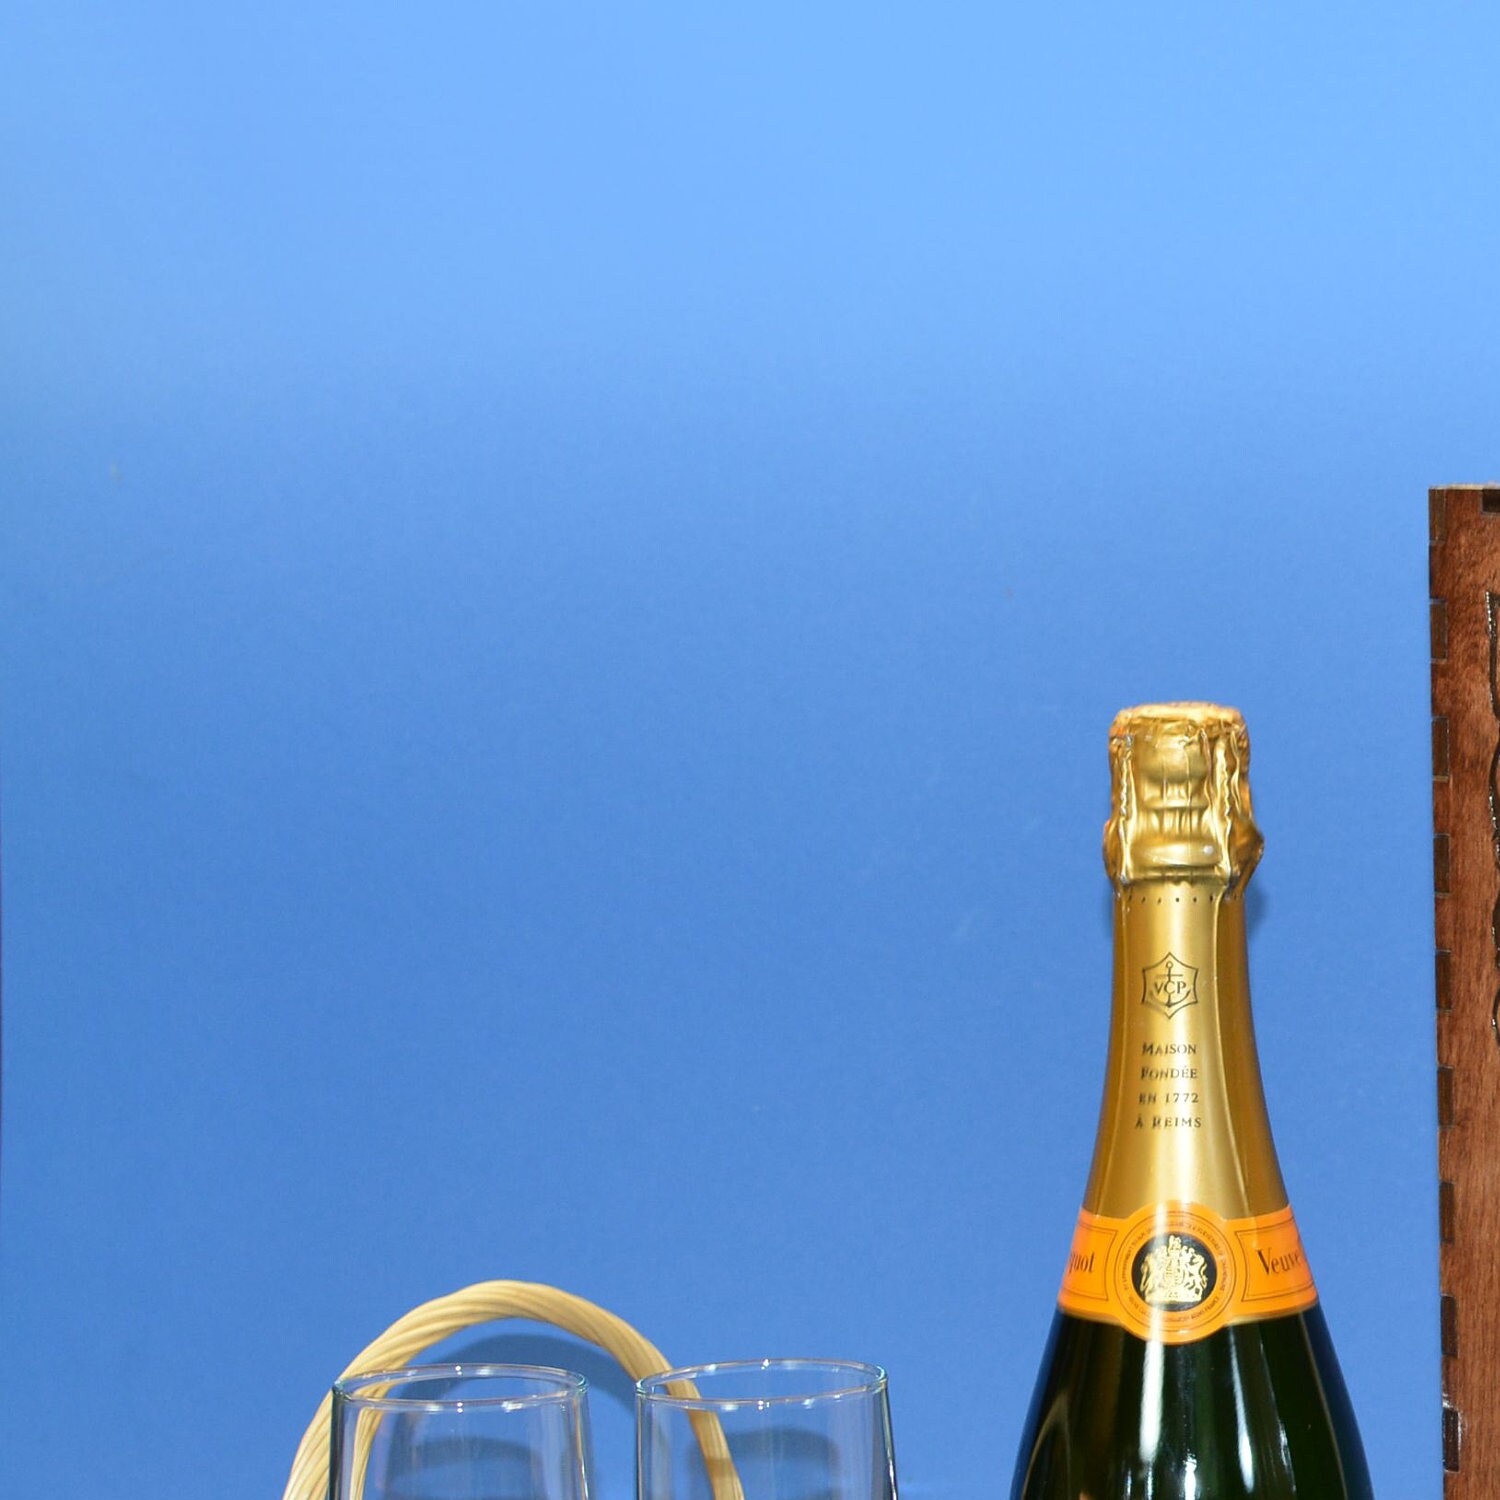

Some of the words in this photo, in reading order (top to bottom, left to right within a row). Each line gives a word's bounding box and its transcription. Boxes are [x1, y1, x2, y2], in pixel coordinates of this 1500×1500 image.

[1153, 980, 1187, 995] VCP
[1142, 1042, 1197, 1055] MAISON
[1141, 1065, 1198, 1080] FONDÉE
[1138, 1092, 1157, 1105] EN
[1165, 1092, 1199, 1104] 1772
[1152, 1117, 1202, 1129] REIMS
